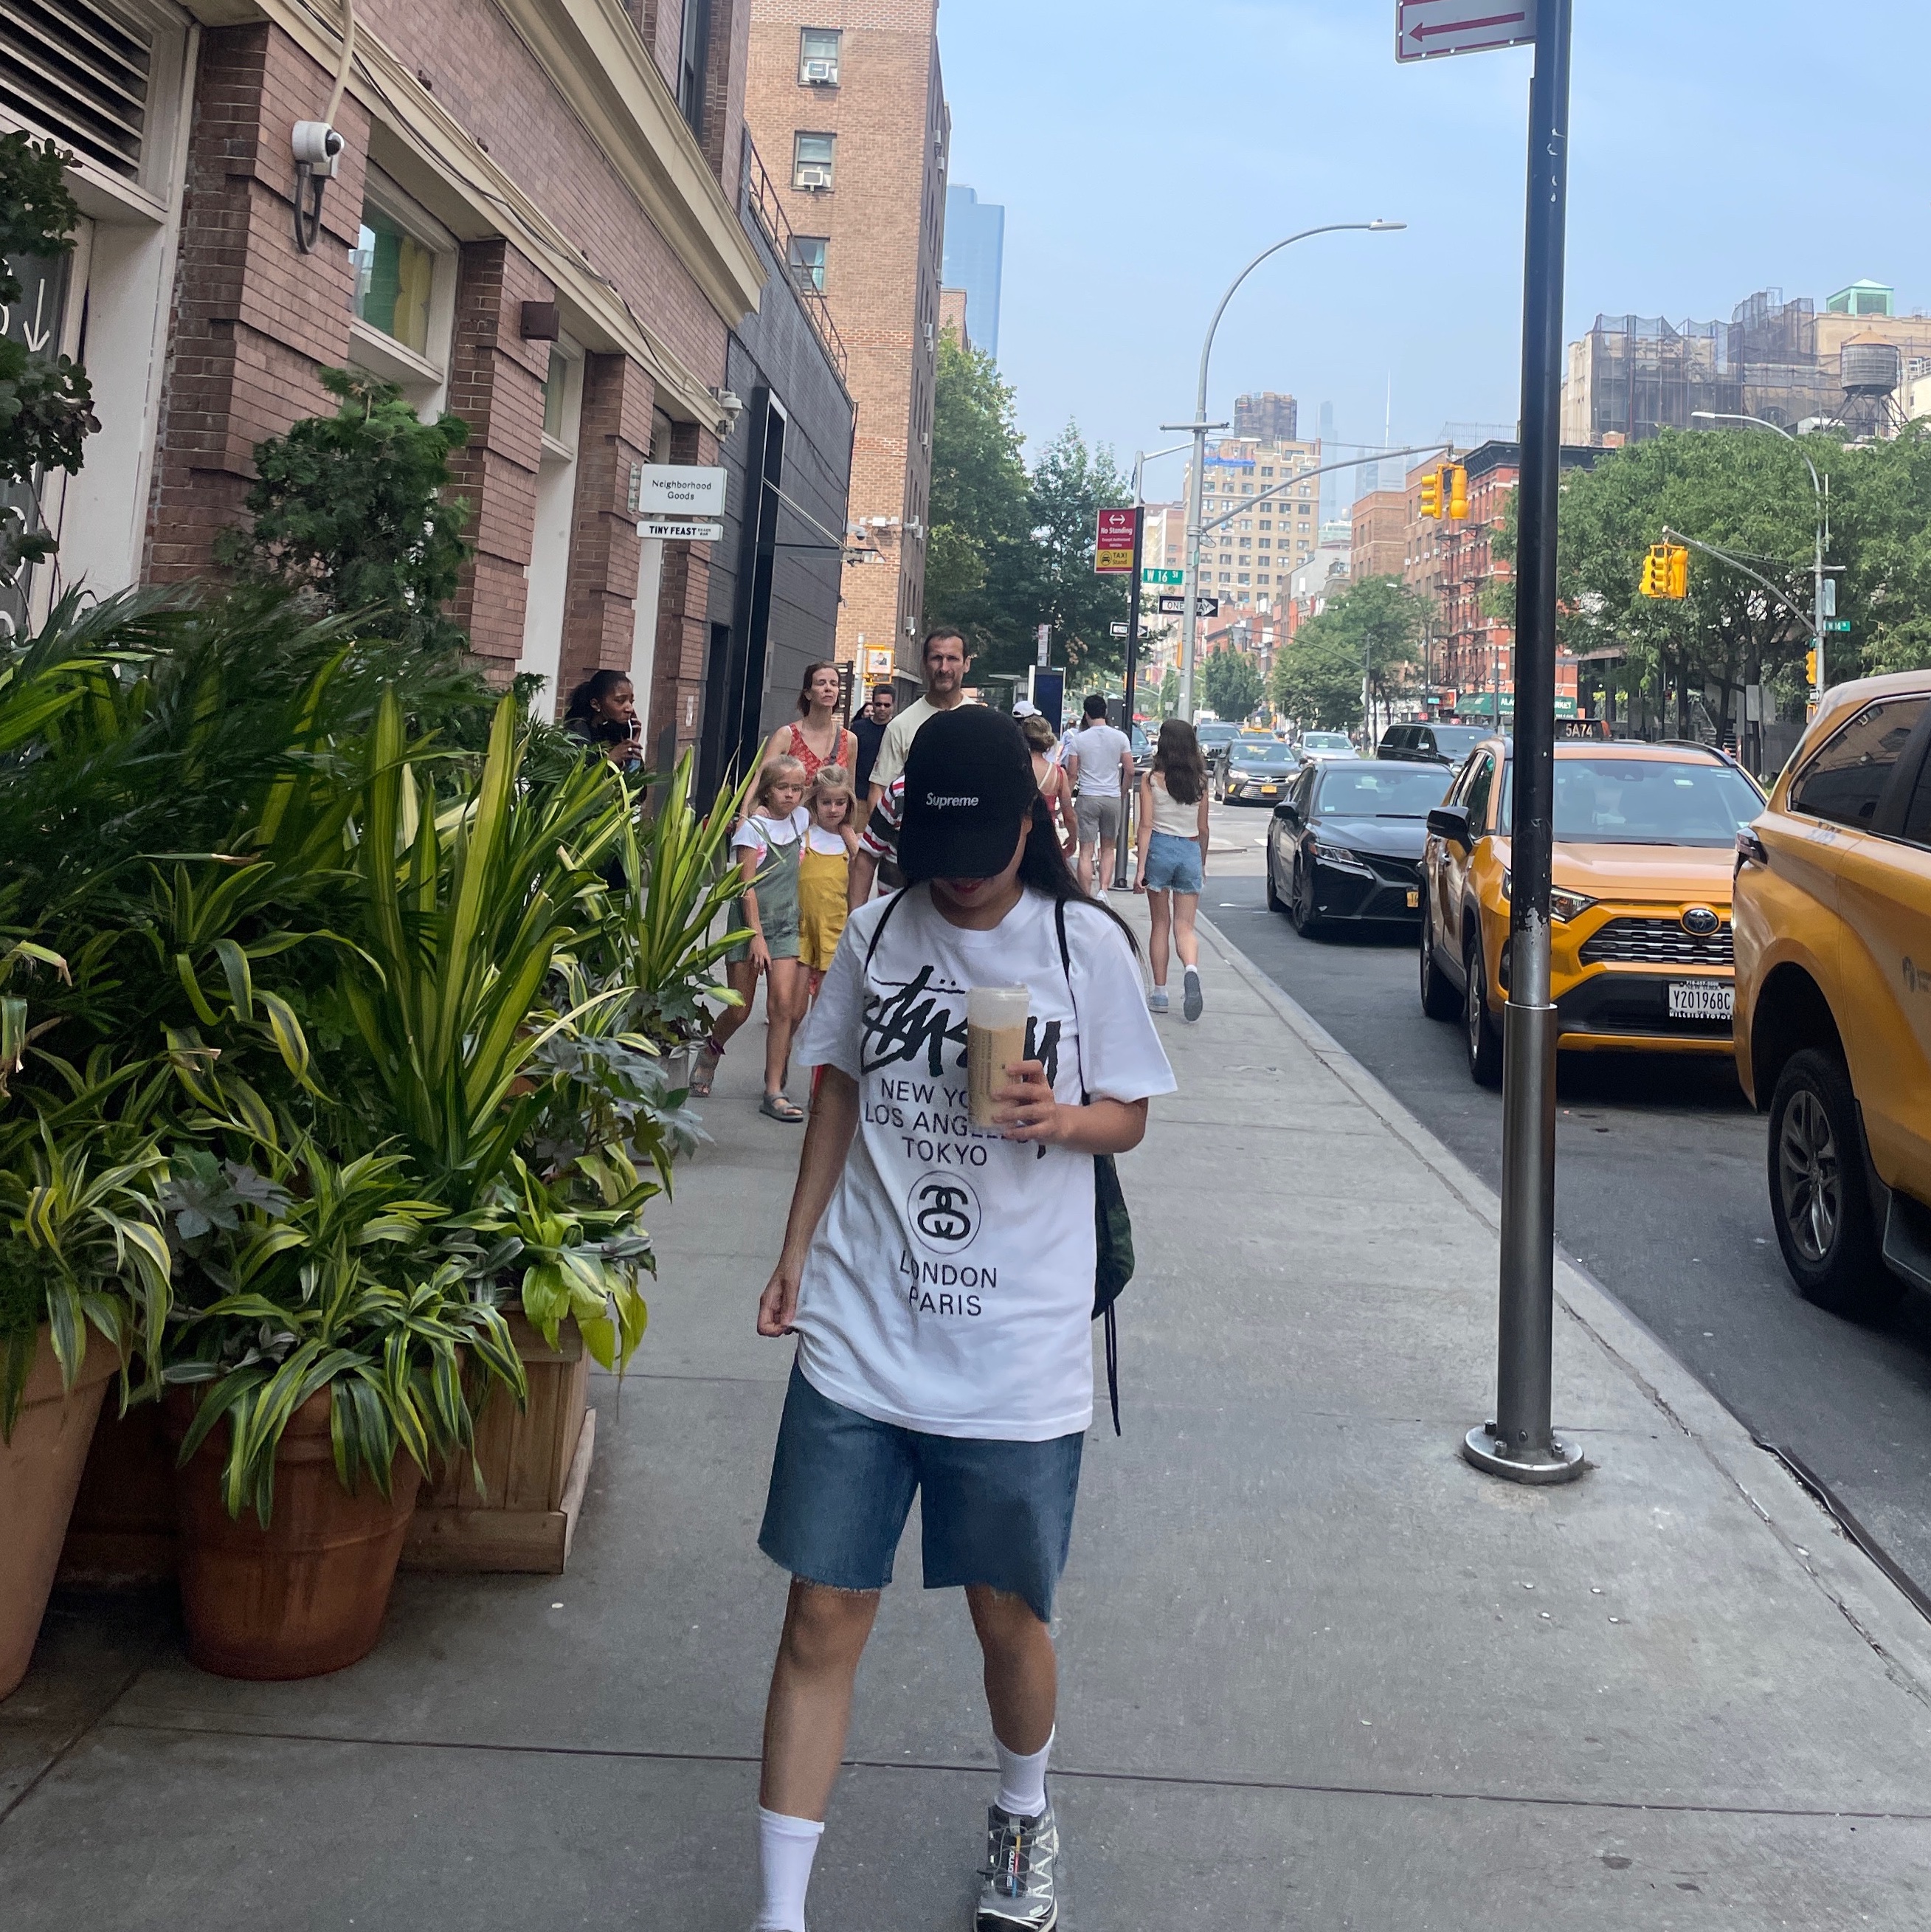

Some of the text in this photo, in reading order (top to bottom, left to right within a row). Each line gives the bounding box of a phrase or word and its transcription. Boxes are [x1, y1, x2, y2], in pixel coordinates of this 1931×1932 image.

[652, 480, 711, 490] Neighborhood
[667, 491, 694, 500] Goods
[649, 525, 697, 536] TINY FEAST
[1109, 526, 1133, 536] Standing
[1147, 569, 1155, 582] W
[1158, 570, 1168, 583] 16
[1167, 601, 1185, 610] ONE
[1566, 723, 1593, 738] 5A74
[926, 792, 979, 810] Supreme
[1673, 990, 1730, 1010] Y201968C
[881, 1078, 936, 1105] NEW
[865, 1102, 904, 1128] LOS
[902, 1136, 987, 1166] TOKYO
[899, 1250, 997, 1288] LONDON
[908, 1286, 982, 1317] PARIS
